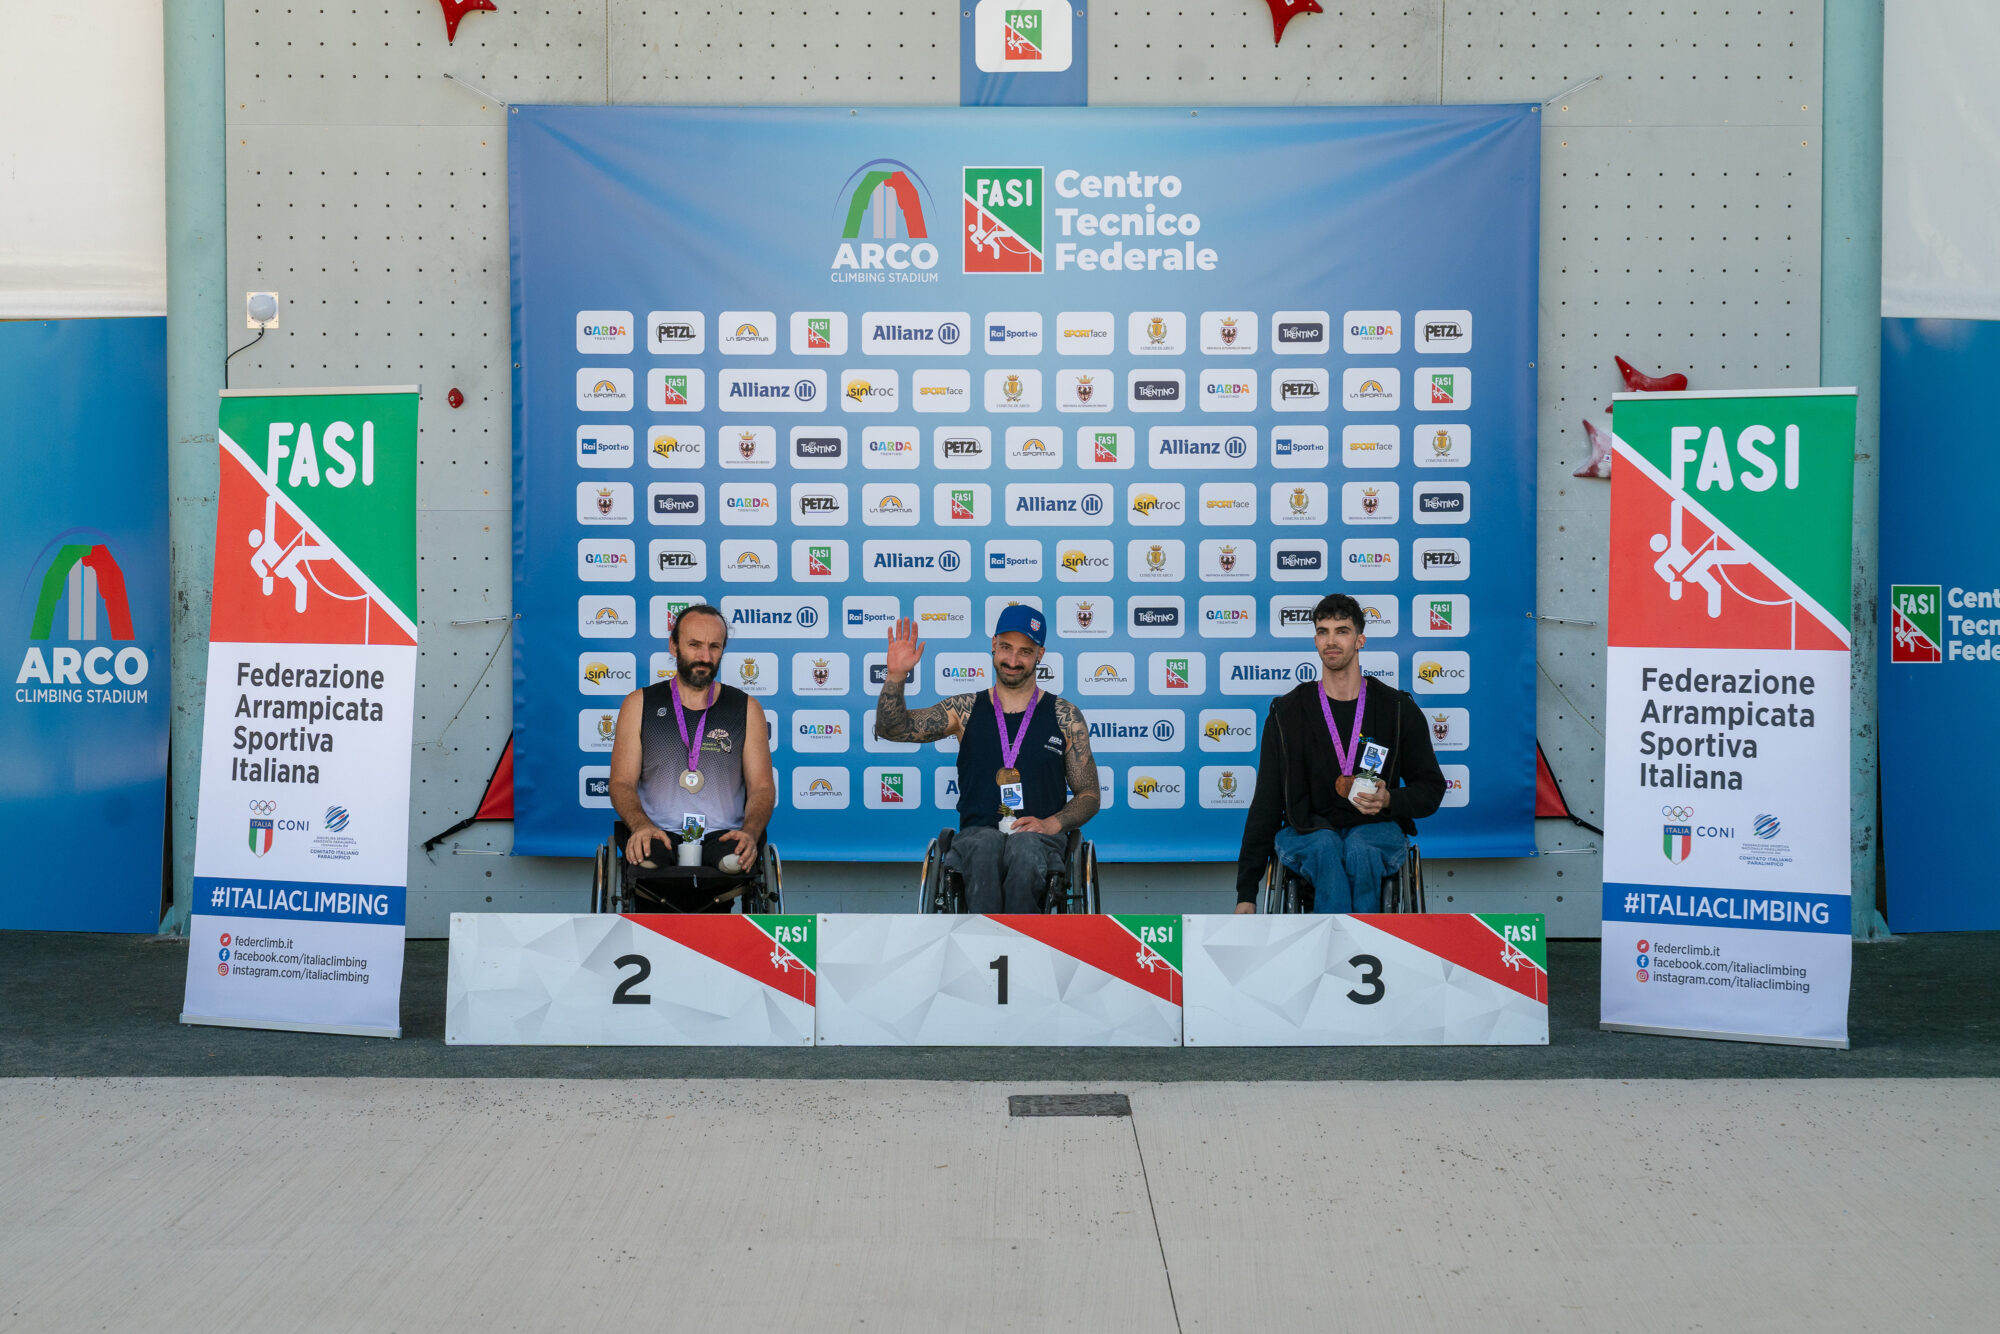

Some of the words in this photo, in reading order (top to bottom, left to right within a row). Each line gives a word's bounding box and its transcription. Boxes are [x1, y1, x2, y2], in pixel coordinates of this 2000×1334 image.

[1011, 15, 1038, 29] FASI
[1055, 169, 1182, 198] Centro
[977, 179, 1033, 207] FASI
[1055, 203, 1200, 236] Tecnico
[831, 243, 939, 269] ARCO
[1056, 241, 1218, 271] Federale
[831, 273, 885, 283] CLIMBING
[888, 273, 938, 283] STADIUM
[584, 326, 626, 336] GARDA
[811, 322, 827, 330] FASI
[1351, 326, 1393, 336] GARDA
[1425, 324, 1463, 342] PETZL
[658, 325, 696, 343] PETZL
[873, 326, 933, 341] Allianz
[991, 329, 1004, 338] Rai
[1006, 330, 1028, 339] Sport
[1282, 329, 1319, 340] TRENTINO
[668, 378, 685, 387] FASI
[1435, 377, 1451, 386] FASI
[729, 383, 790, 398] Allianz
[850, 385, 894, 396] sintroc
[1138, 387, 1175, 398] TRENTINO
[1207, 384, 1250, 394] GARDA
[1282, 383, 1320, 400] PETZL
[583, 442, 596, 451] Rai
[598, 443, 620, 452] Sport
[656, 441, 701, 452] sintroc
[870, 441, 912, 451] GARDA
[1098, 436, 1114, 445] FASI
[1159, 440, 1220, 455] Allianz
[267, 420, 374, 488] FASI
[801, 444, 837, 455] TRENTINO
[945, 441, 983, 458] PETZL
[1277, 443, 1290, 451] Rai
[1292, 443, 1314, 453] Sport
[1671, 424, 1800, 492] FASI
[727, 497, 769, 508] GARDA
[955, 493, 971, 502] FASI
[1016, 497, 1077, 512] Allianz
[1137, 499, 1181, 510] sintroc
[1423, 499, 1460, 509] TRENTINO
[658, 500, 694, 511] TRENTINO
[802, 497, 840, 515] PETZL
[585, 553, 628, 564] GARDA
[812, 549, 829, 558] FASI
[873, 553, 934, 568] Allianz
[1065, 555, 1109, 566] sintroc
[1349, 553, 1391, 563] GARDA
[660, 553, 698, 571] PETZL
[991, 557, 1004, 565] Rai
[1006, 557, 1028, 567] Sport
[1281, 557, 1317, 567] TRENTINO
[1423, 552, 1461, 570] PETZL
[1433, 604, 1450, 613] FASI
[1900, 594, 1934, 614] FASI
[731, 609, 792, 624] Allianz
[849, 613, 862, 621] Rai
[864, 613, 886, 623] Sport
[1138, 613, 1174, 624] TRENTINO
[1206, 610, 1248, 620] GARDA
[16, 646, 148, 685] ARCO
[942, 667, 985, 678] GARDA
[1169, 662, 1186, 671] FASI
[1421, 667, 1466, 678] sintroc
[237, 662, 385, 690] Federazione
[588, 668, 632, 679] sintroc
[1230, 665, 1291, 681] Allianz
[1641, 667, 1815, 695] Federazione
[16, 689, 82, 703] CLIMBING
[86, 689, 148, 704] STADIUM
[235, 694, 383, 724] Arrampicata
[1640, 699, 1815, 730] Arrampicata
[799, 724, 842, 735] GARDA
[1089, 723, 1148, 737] Allianz
[1208, 725, 1252, 736] sintroc
[232, 726, 334, 754] Sportiva
[1640, 731, 1758, 760] Sportiva
[231, 757, 320, 784] Italiana
[1640, 763, 1743, 790] Italiana
[884, 776, 901, 785] FASI
[1137, 782, 1181, 793] sintroc
[278, 820, 309, 831] CONI
[1697, 826, 1734, 838] CONI
[211, 886, 389, 916] #ITALIACLIMBING
[1624, 892, 1830, 924] #ITALIACLIMBING
[775, 926, 807, 943] FASI
[1141, 926, 1172, 943] FASI
[1504, 925, 1536, 942] FASI
[235, 935, 293, 949] federclimb.it
[1654, 942, 1720, 957] federclimb.it
[234, 949, 367, 970] facebook.com/italiaclimbing
[232, 964, 369, 984] instagram.com/italiaclimbing
[1653, 957, 1807, 978] facebook.com/italiaclimbing
[612, 954, 651, 1004] 2
[990, 955, 1008, 1004] 1
[1346, 954, 1385, 1005] 3
[1653, 971, 1810, 993] instagram.com/italiaclimbing
